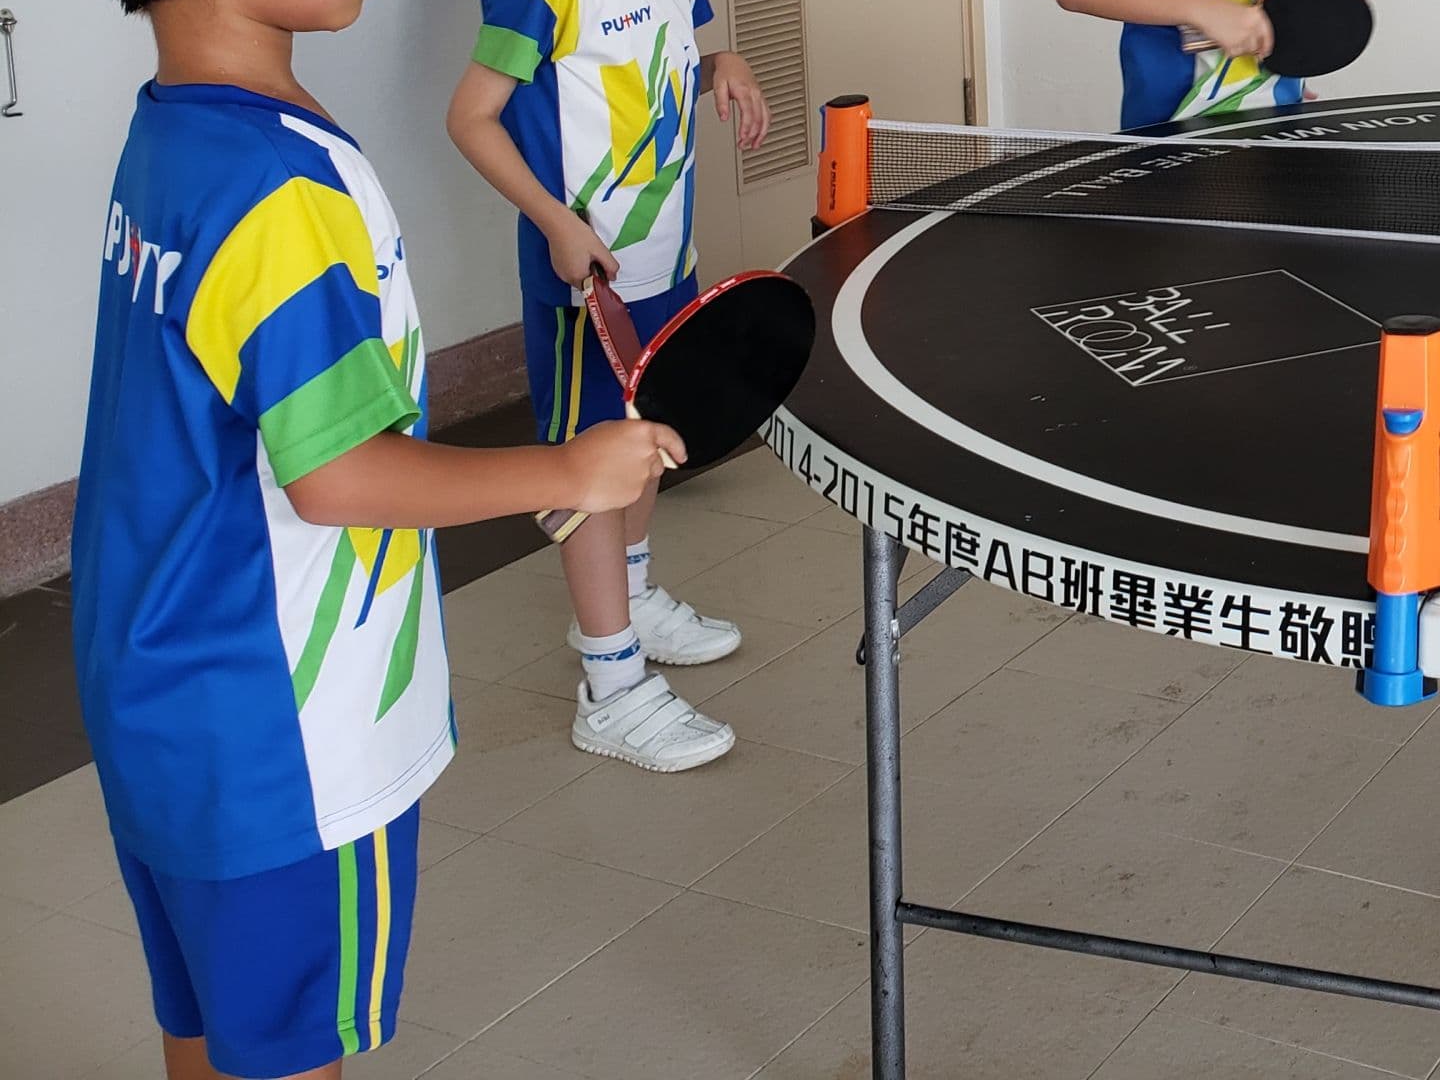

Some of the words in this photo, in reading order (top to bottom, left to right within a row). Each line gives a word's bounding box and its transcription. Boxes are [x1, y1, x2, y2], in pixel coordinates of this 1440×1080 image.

[1341, 113, 1437, 131] JOIN
[1260, 126, 1341, 141] WIT
[1140, 147, 1231, 169] THE
[1043, 168, 1152, 198] BALL
